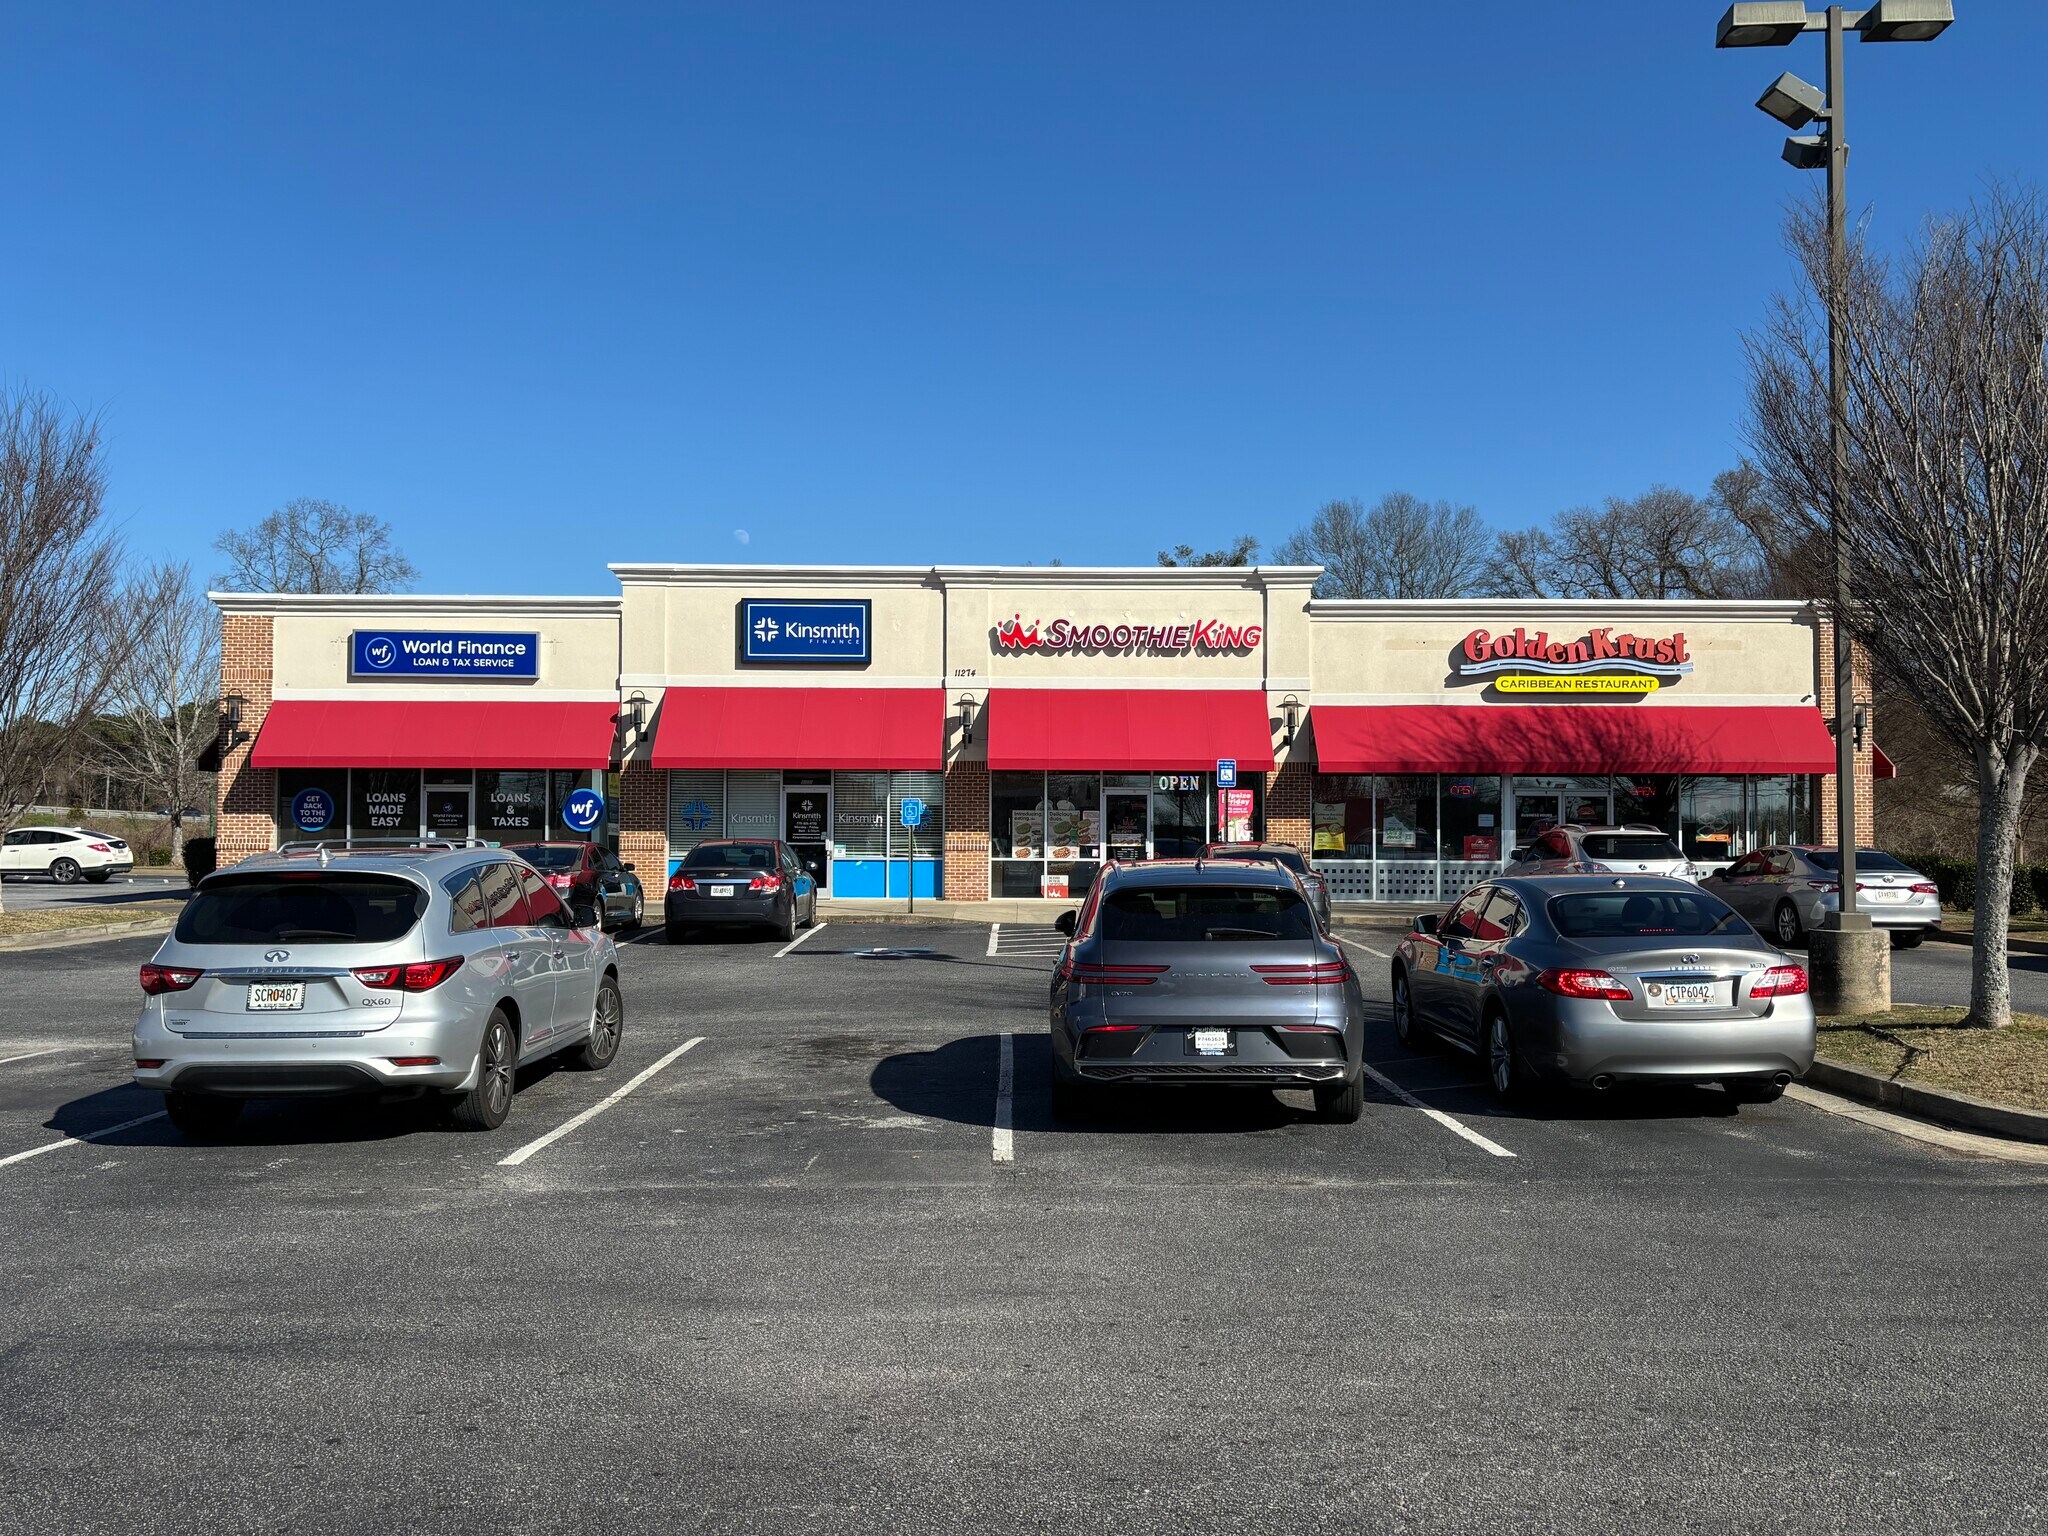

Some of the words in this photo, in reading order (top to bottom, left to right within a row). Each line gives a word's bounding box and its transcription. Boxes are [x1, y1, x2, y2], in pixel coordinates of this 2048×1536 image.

[785, 622, 860, 638] Kinsmith
[402, 640, 453, 655] World
[458, 640, 526, 655] Finance
[1464, 627, 1588, 663] Golden
[1588, 627, 1691, 664] Krust
[413, 658, 440, 667] LOAN
[442, 659, 450, 667] &
[452, 658, 471, 667] TAX
[473, 659, 514, 668] SERVICE
[954, 669, 976, 677] 11274
[1500, 680, 1572, 689] CARIBBEAN
[1575, 680, 1655, 689] RESTAURANT
[1159, 776, 1200, 791] OPEN
[366, 793, 406, 803] LOANS
[490, 793, 531, 803] LOANS
[368, 805, 404, 815] MADE
[506, 805, 515, 815] &
[371, 817, 401, 826] EASY
[492, 817, 529, 827] TAXES
[731, 813, 776, 824] Kinsmith
[838, 813, 883, 824] Kinsmith
[254, 988, 298, 1002] SCR0487
[1670, 986, 1710, 998] CTP6042
[362, 998, 391, 1007] QX60
